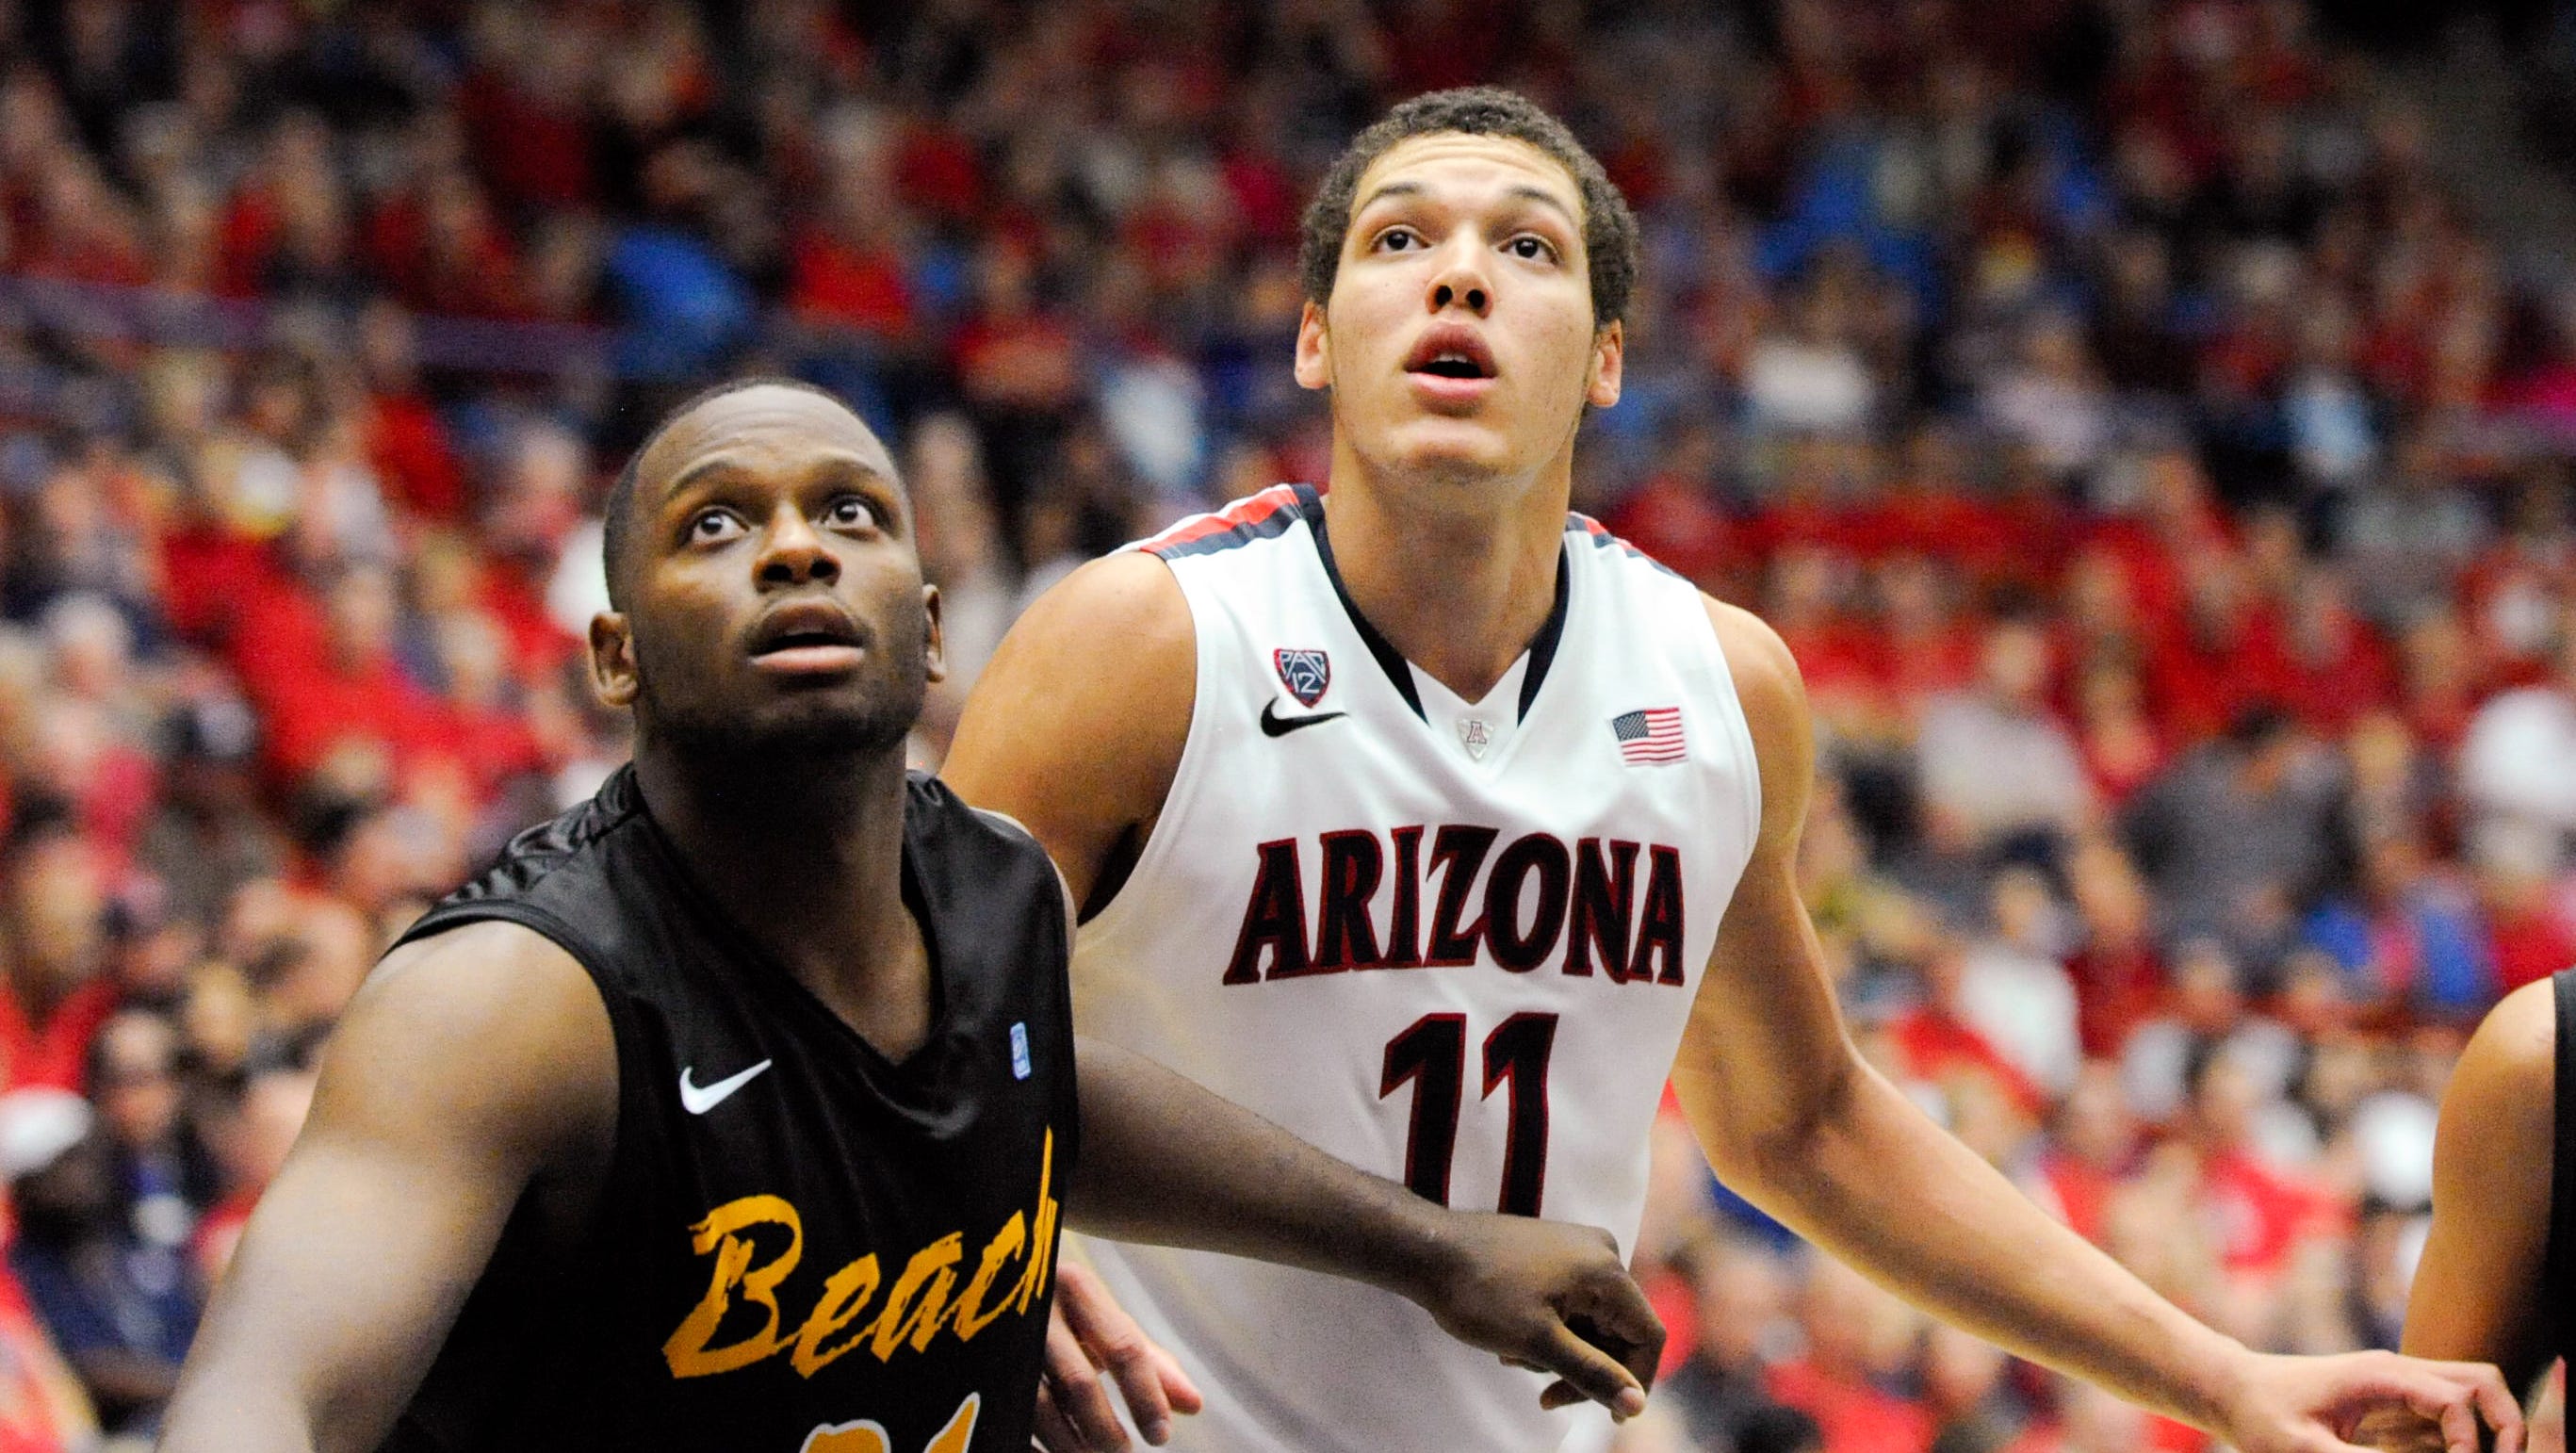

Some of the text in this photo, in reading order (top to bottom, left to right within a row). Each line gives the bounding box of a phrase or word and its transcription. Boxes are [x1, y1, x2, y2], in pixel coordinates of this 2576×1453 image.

[1280, 651, 1327, 684] PAC
[1292, 672, 1321, 694] 12
[1466, 720, 1487, 744] A
[1223, 824, 1685, 987] ARIZONA
[1379, 1011, 1559, 1218] 11
[661, 1123, 1058, 1380] Beach
